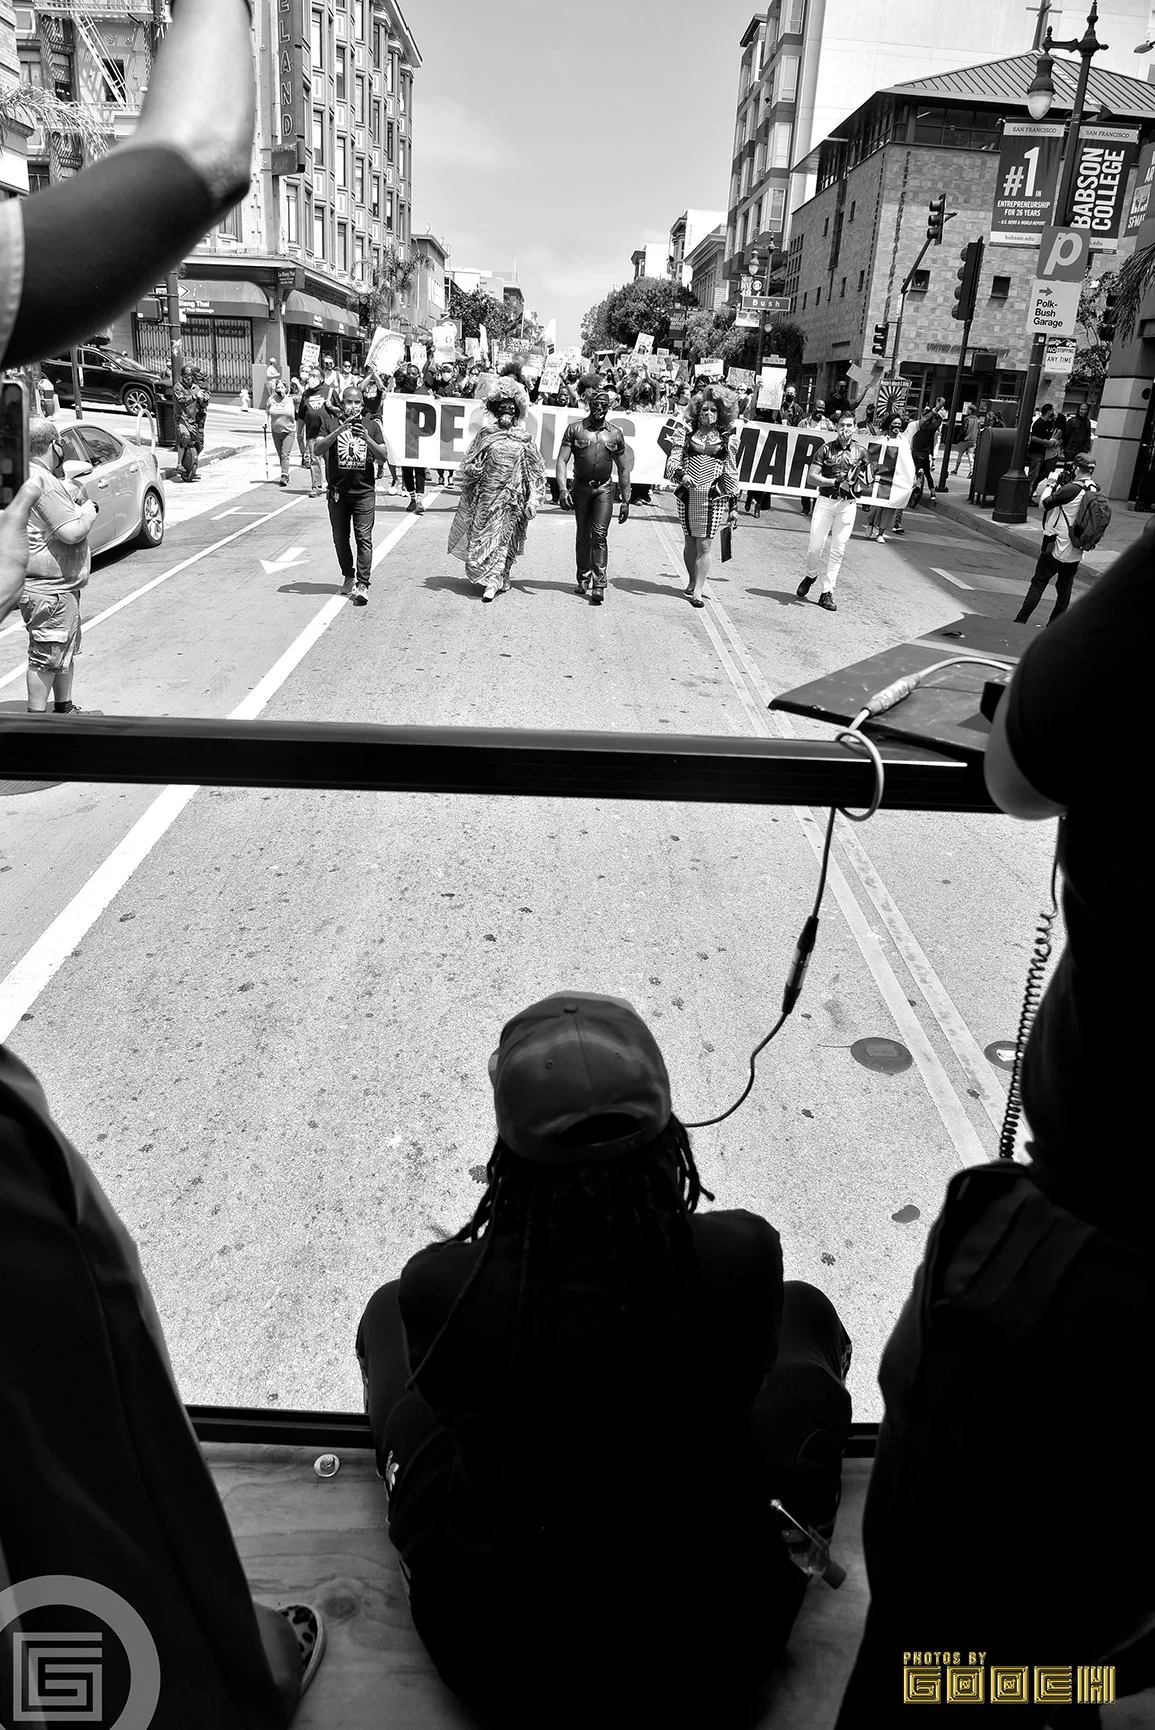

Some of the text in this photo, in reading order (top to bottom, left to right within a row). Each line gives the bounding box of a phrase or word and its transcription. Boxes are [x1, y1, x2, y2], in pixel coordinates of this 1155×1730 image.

[1099, 131, 1130, 139] FRANCISCO
[1003, 146, 1040, 197] #1
[1070, 147, 1105, 229] BABSON
[1091, 149, 1125, 231] COLLEGE
[997, 200, 1051, 209] ENTREPRENEURSHIP
[1004, 208, 1016, 216] FOR
[1024, 209, 1041, 217] YEARS
[752, 298, 780, 308] Bush
[1036, 298, 1058, 308] Polk-
[1034, 307, 1056, 318] Bush
[1033, 317, 1063, 328] Garage
[1060, 356, 1072, 364] TIME
[736, 427, 900, 501] MARH
